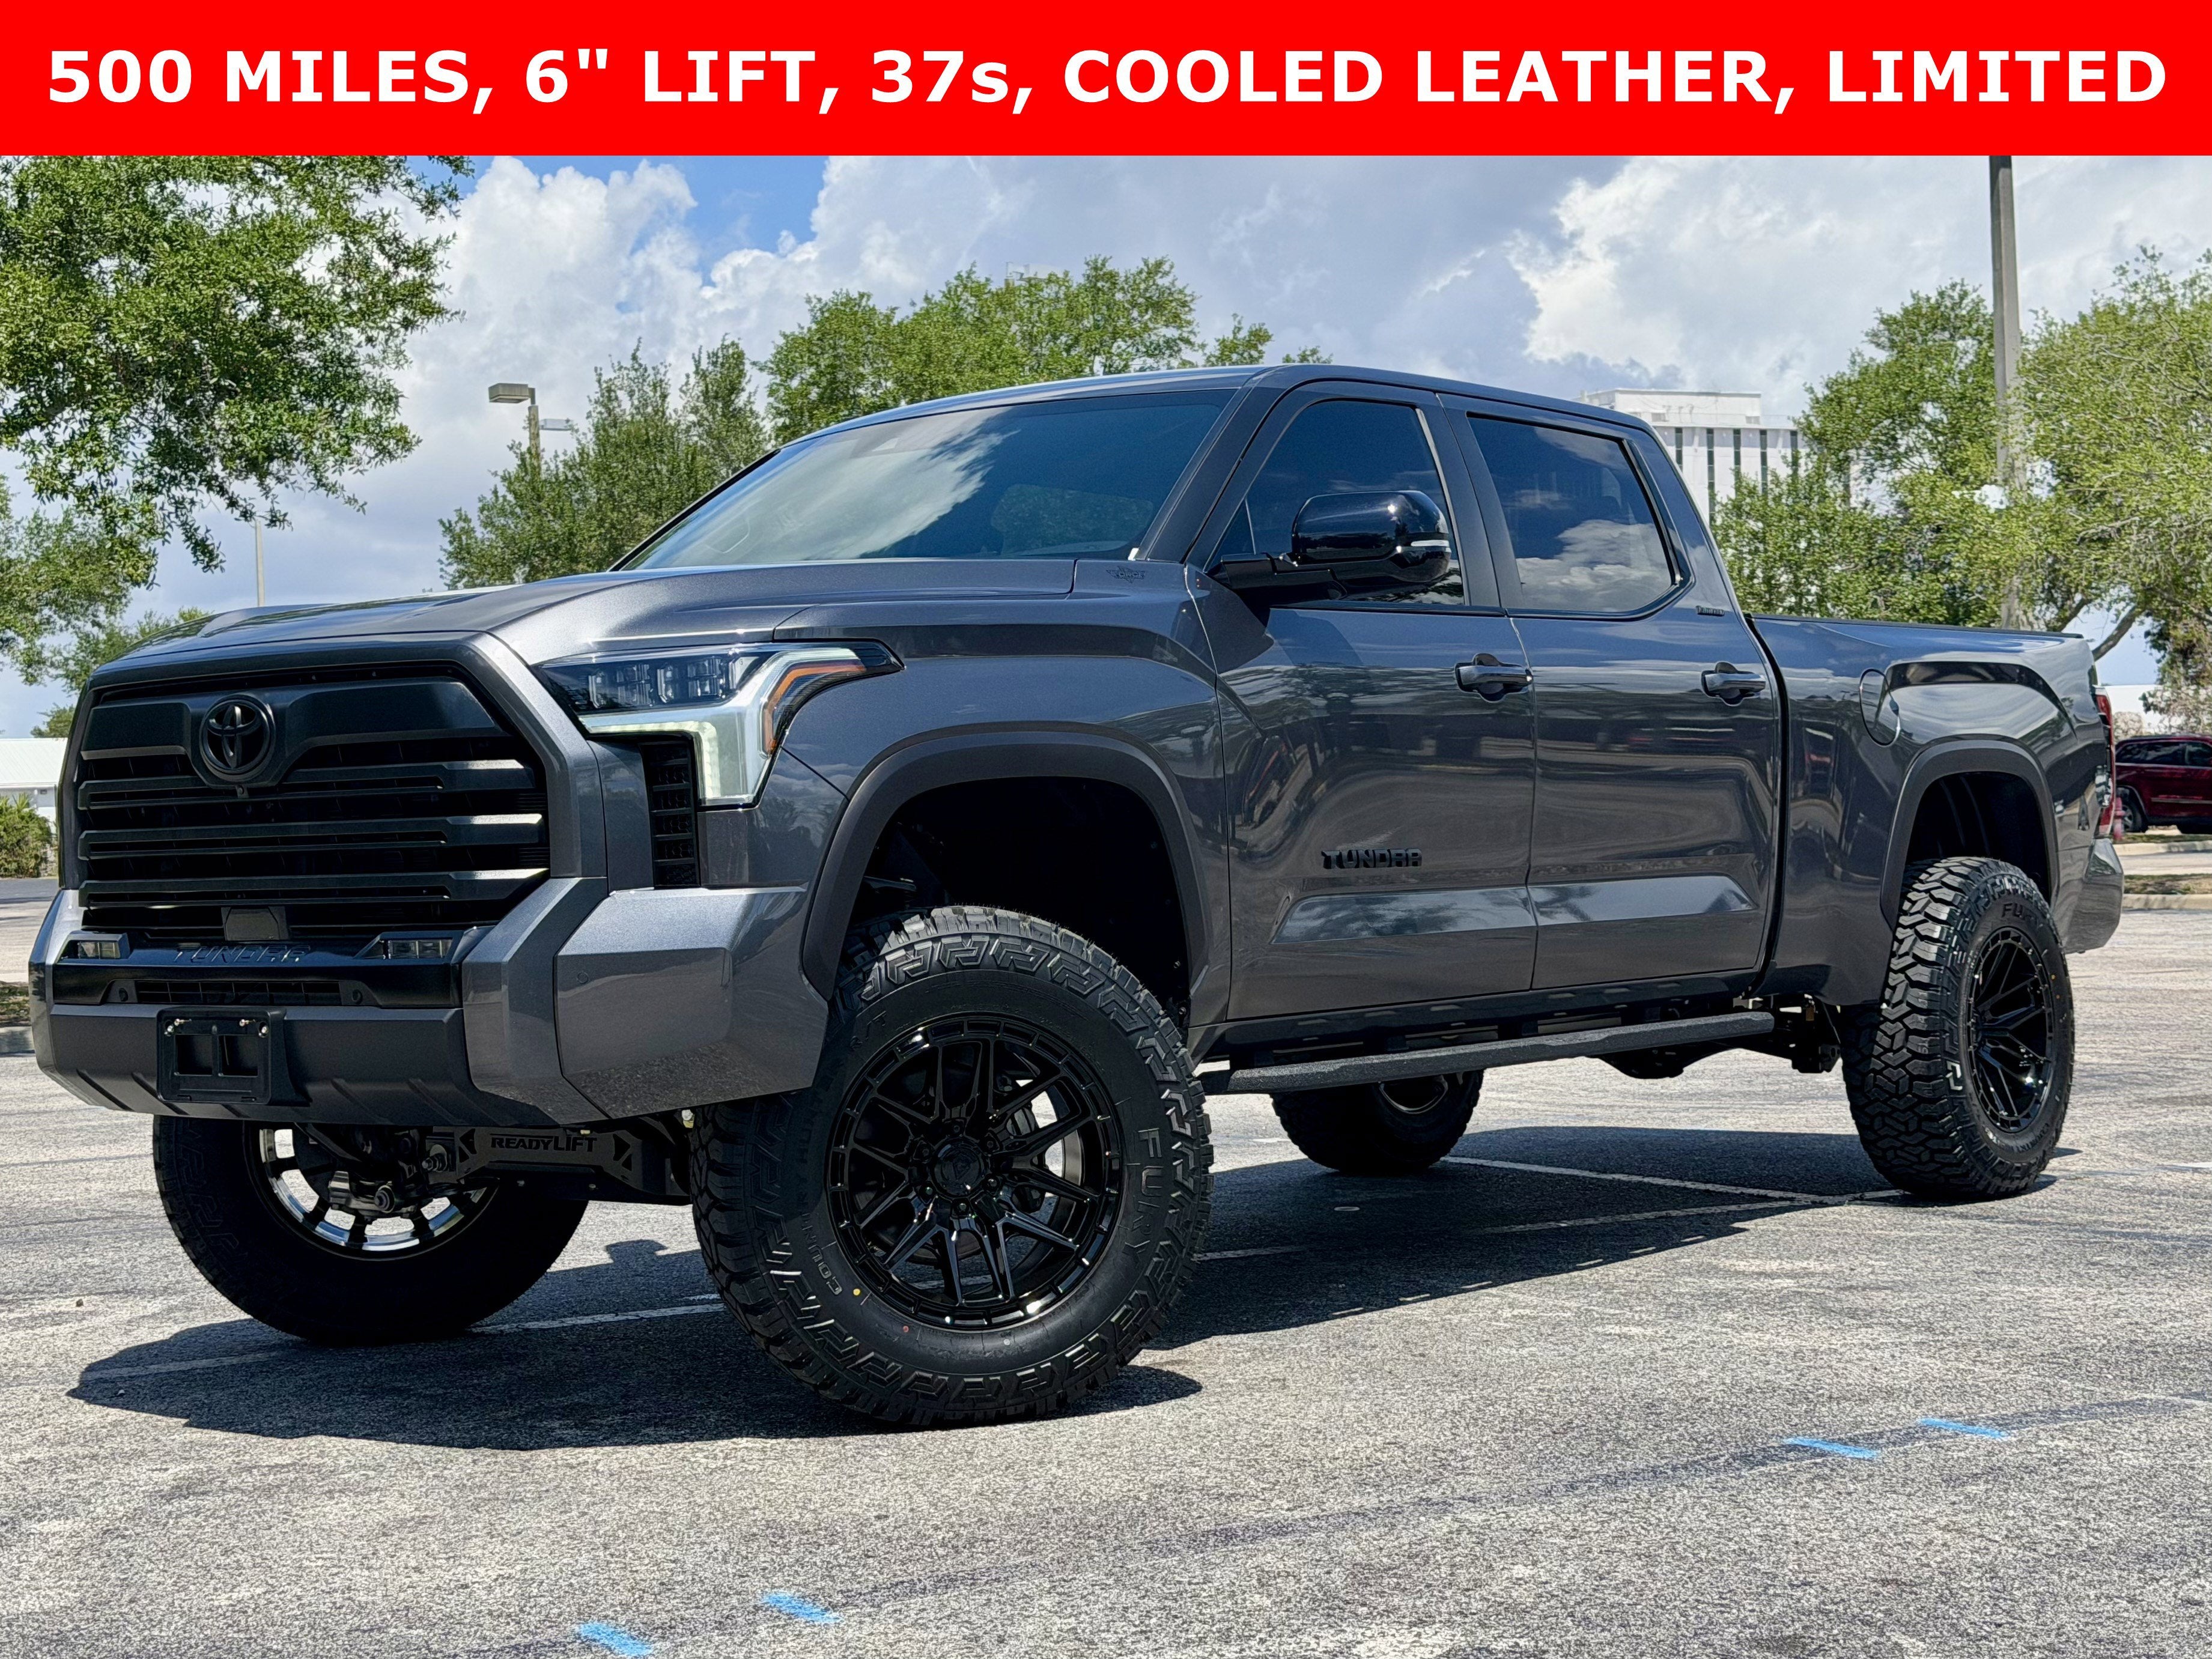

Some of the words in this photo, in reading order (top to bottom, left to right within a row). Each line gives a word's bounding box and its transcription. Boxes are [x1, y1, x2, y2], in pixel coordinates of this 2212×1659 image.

[1321, 848, 1423, 870] TUNDRA
[172, 944, 311, 963] TUNDRA
[491, 1135, 597, 1152] READYLIFT
[1122, 1127, 1163, 1270] FURY
